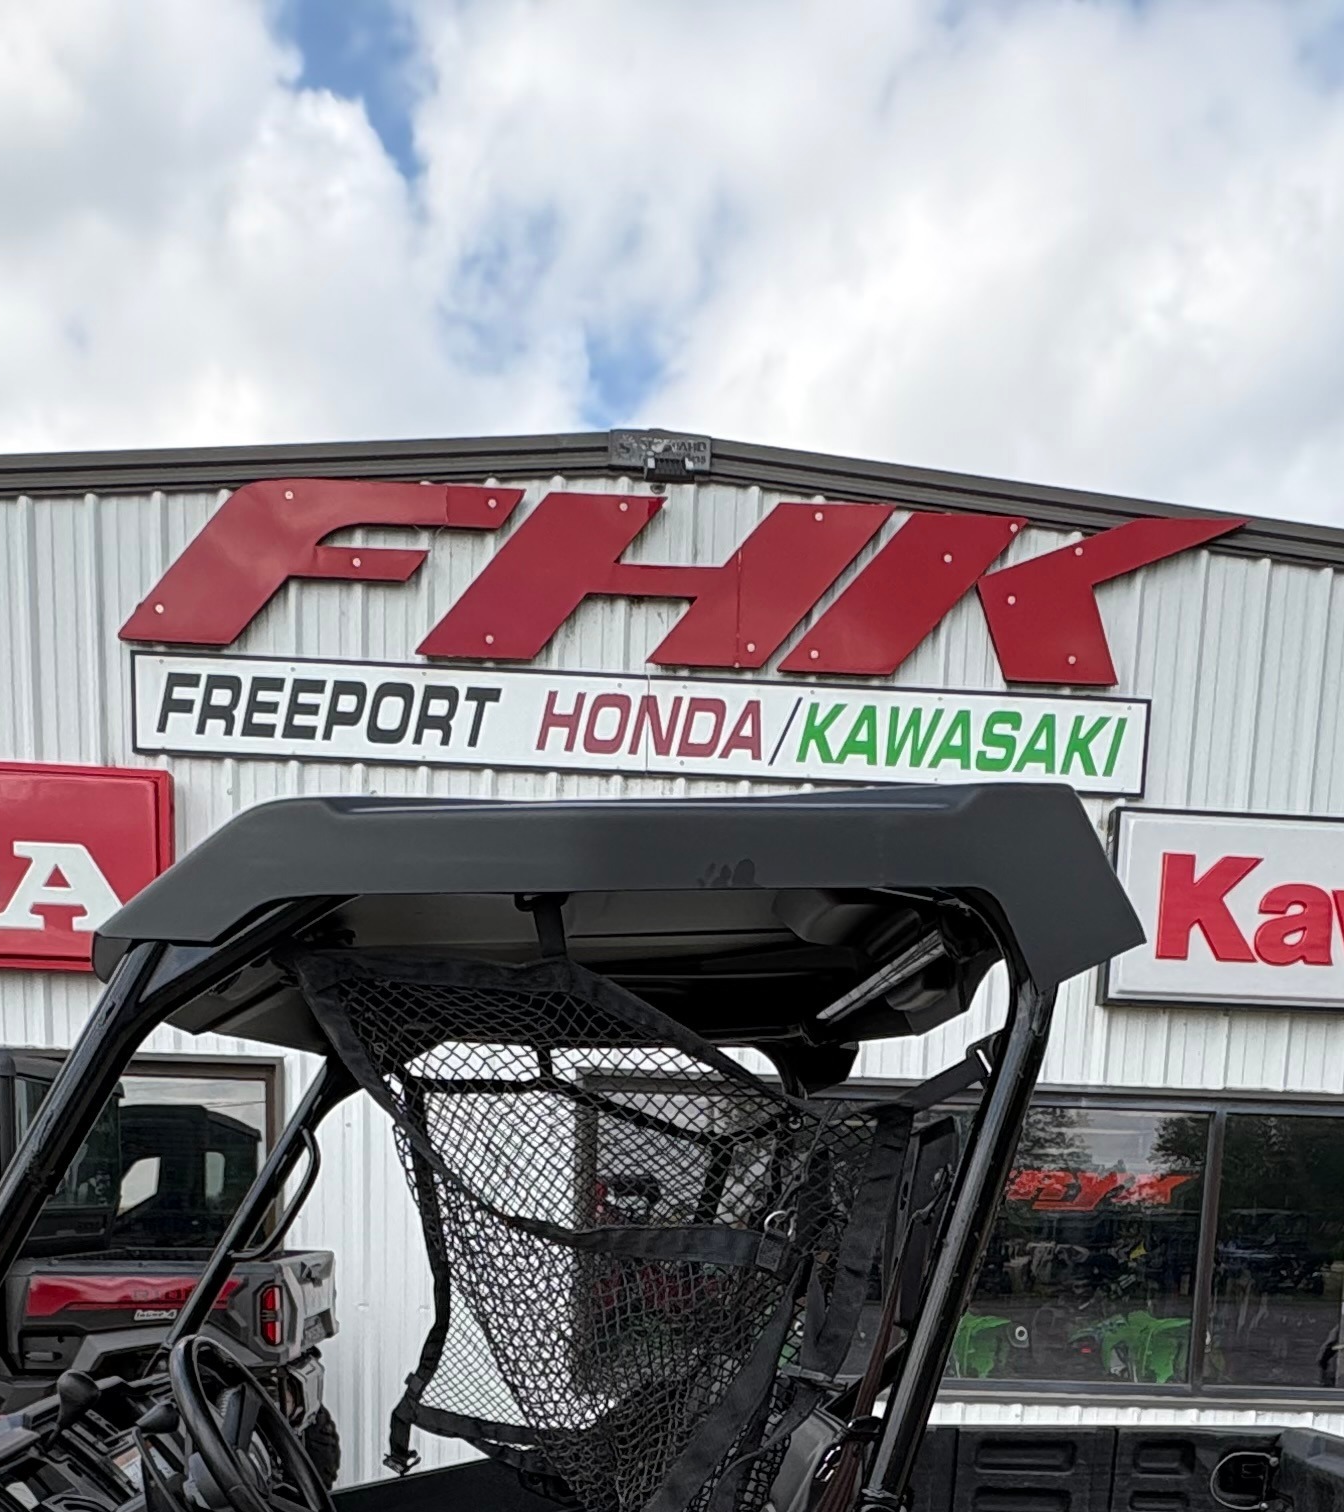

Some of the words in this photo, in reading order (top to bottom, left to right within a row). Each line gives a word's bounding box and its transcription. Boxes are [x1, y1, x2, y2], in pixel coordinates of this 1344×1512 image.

[119, 479, 1252, 686] FHK
[156, 672, 502, 748] FREEPORT
[535, 688, 1127, 777] HONDA/KAWASAKI
